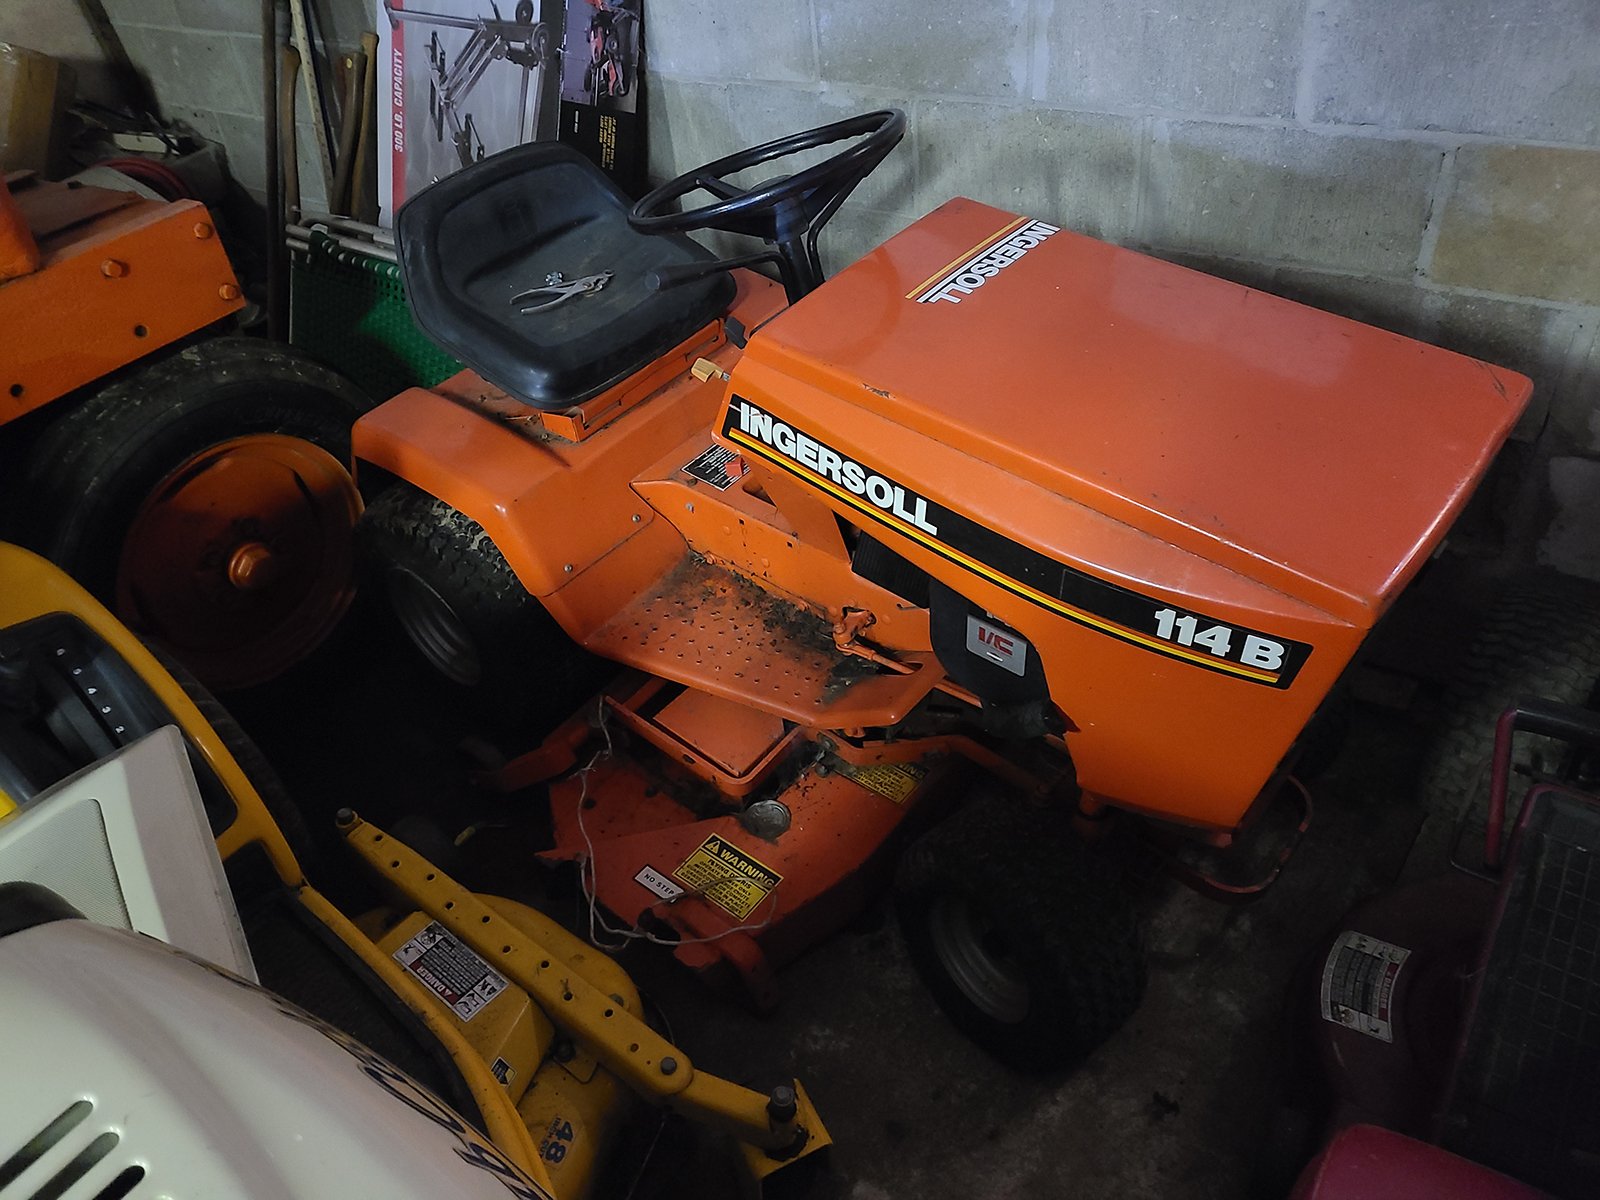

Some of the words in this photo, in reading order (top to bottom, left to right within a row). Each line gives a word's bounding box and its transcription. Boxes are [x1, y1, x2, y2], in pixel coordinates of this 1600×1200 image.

[393, 48, 403, 107] CAPACITY
[394, 111, 403, 129] LB.
[394, 130, 404, 152] 300
[928, 221, 1061, 304] INGERSOLL
[740, 401, 938, 536] INGERSOLL
[1154, 608, 1232, 657] 114
[1240, 634, 1285, 670] B
[644, 873, 654, 883] NO
[656, 881, 675, 896] STEP
[720, 848, 775, 886] WARNING
[416, 965, 445, 993] DANGER
[544, 1121, 574, 1164] 48
